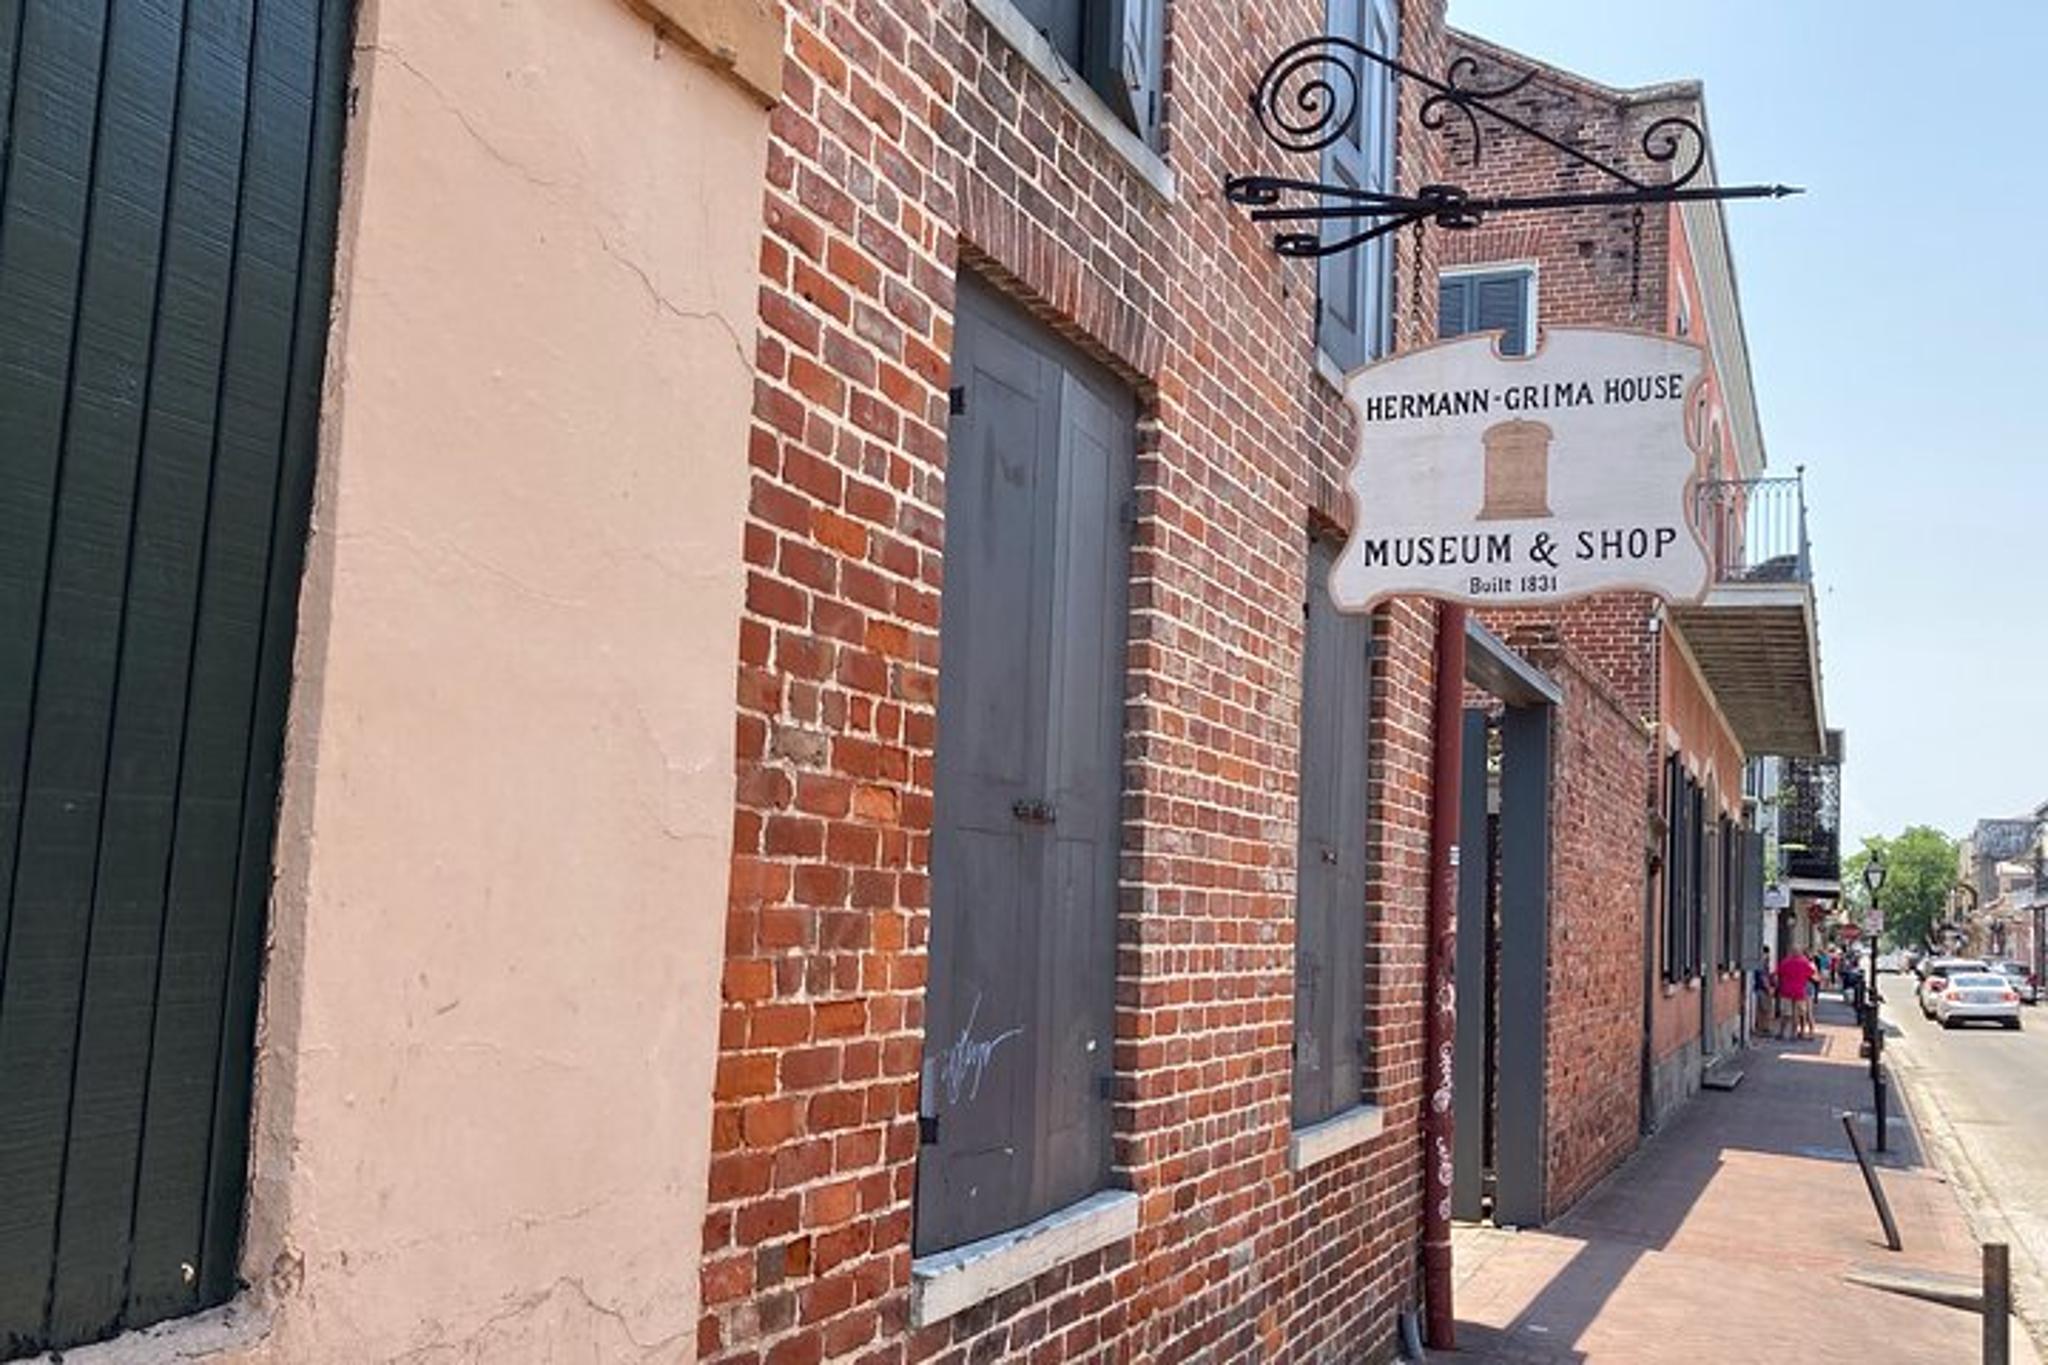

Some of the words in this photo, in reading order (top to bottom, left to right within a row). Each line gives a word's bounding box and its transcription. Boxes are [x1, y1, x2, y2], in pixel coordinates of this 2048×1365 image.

[1367, 381, 1594, 422] HERMANN-GRIMA
[1604, 374, 1683, 405] HOUSE
[1363, 533, 1512, 568] MUSEUM
[1528, 531, 1560, 567] &
[1575, 527, 1677, 560] SHOP
[1469, 577, 1511, 594] Built
[1520, 576, 1558, 593] 1831
